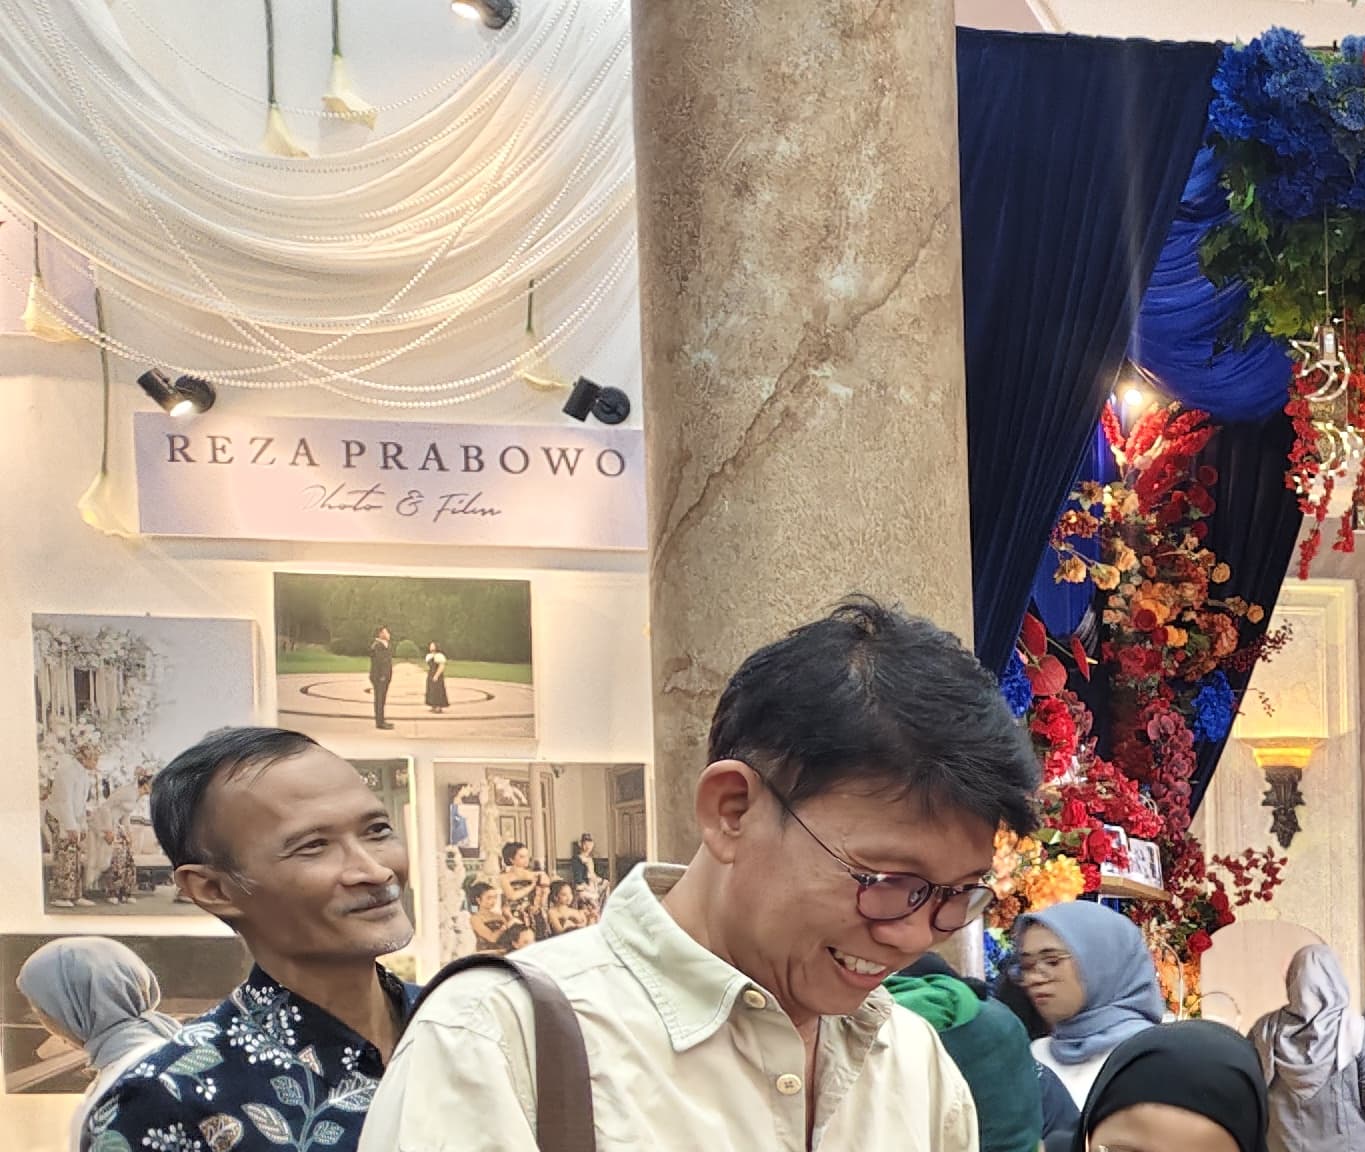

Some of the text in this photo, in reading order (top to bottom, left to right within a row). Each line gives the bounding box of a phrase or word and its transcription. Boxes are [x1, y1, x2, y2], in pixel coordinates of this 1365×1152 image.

[166, 433, 627, 478] REZA PRABOWO
[396, 489, 424, 516] &
[433, 492, 502, 523] Film
